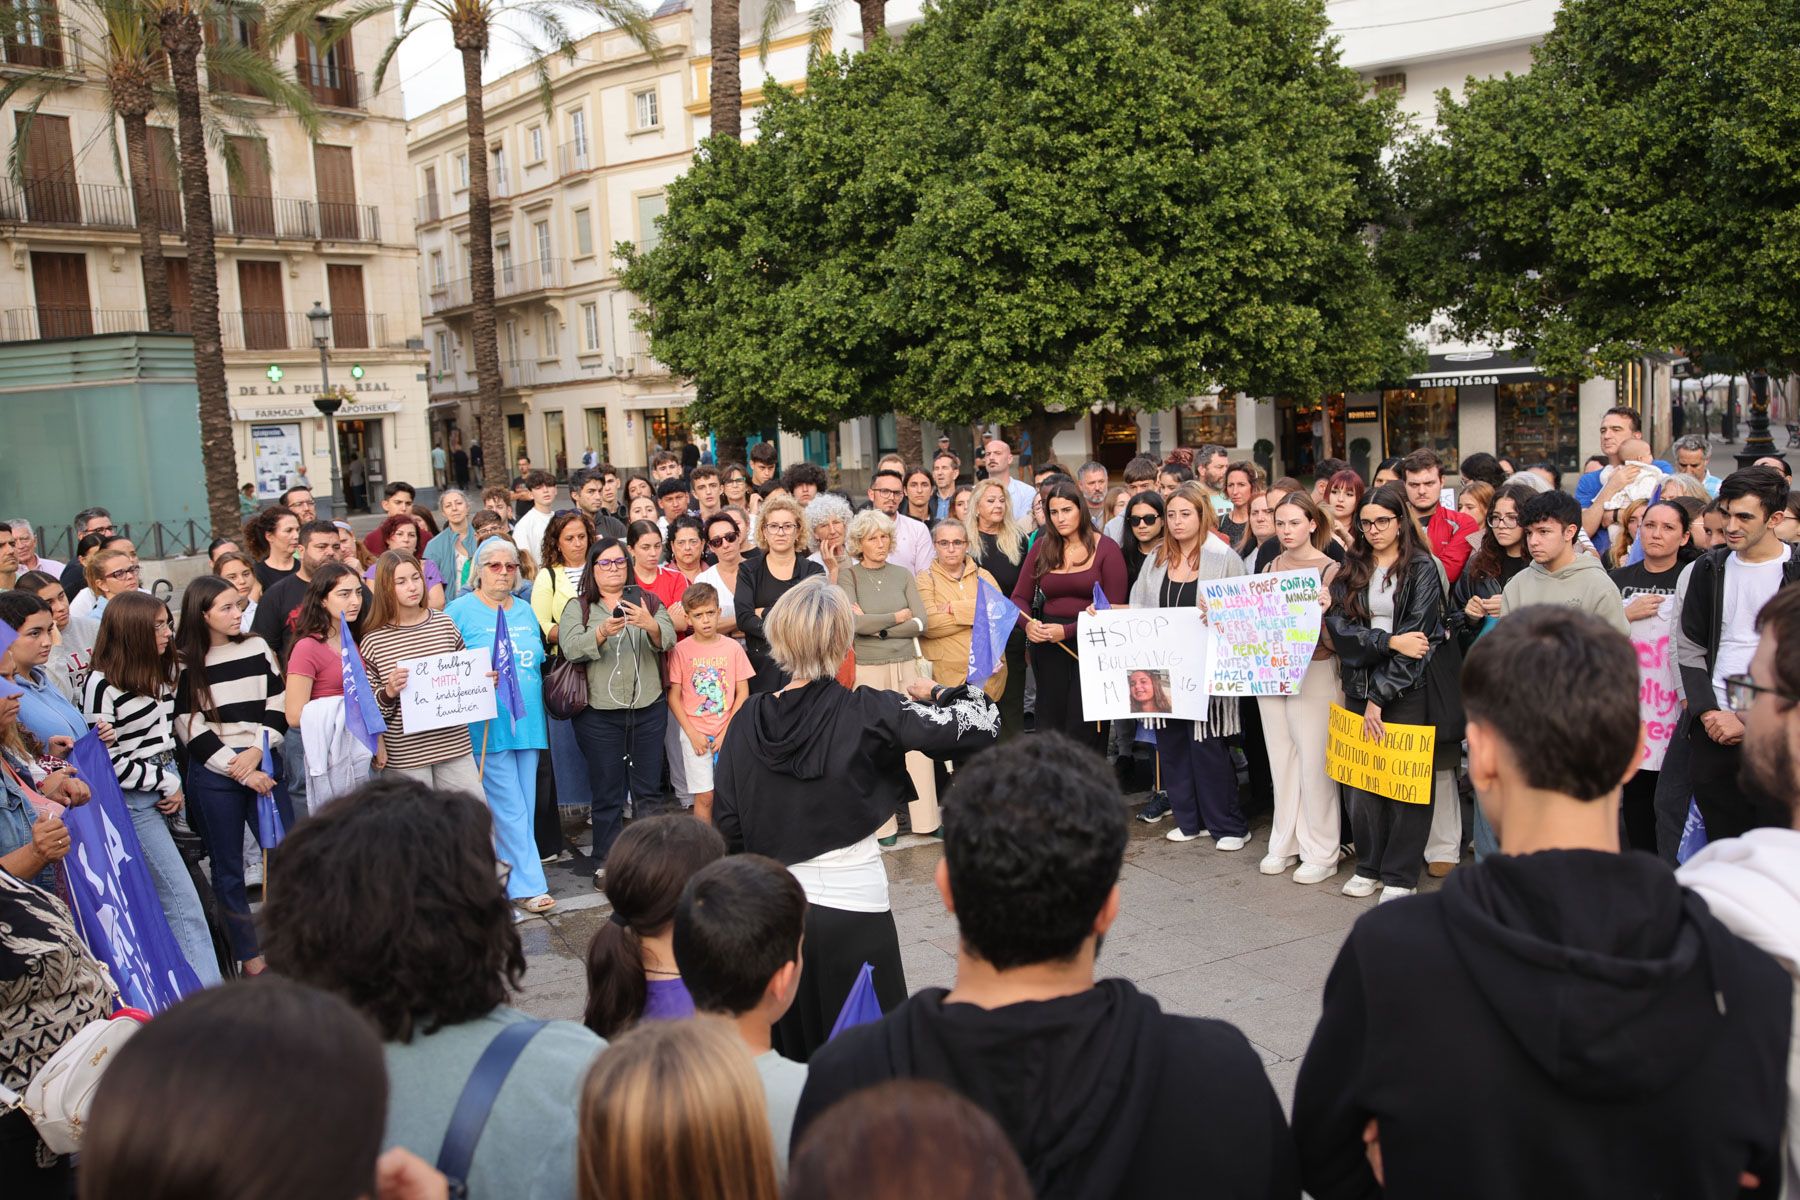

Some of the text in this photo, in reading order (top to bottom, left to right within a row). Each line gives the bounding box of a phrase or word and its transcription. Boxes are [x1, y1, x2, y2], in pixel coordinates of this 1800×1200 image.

[240, 380, 390, 396] DE LA PUETA REAL
[1420, 375, 1499, 388] miscelánea
[255, 403, 389, 418] FARMACIA APOTHEKE
[1206, 584, 1222, 599] NO
[1254, 615, 1297, 631] VALIENTE
[1086, 615, 1169, 648] #STOP
[415, 661, 429, 676] El
[1098, 650, 1184, 672] BULLYING
[1255, 655, 1269, 668] DE
[1271, 655, 1289, 668] QUE
[1214, 669, 1254, 681] HAZLO
[414, 685, 488, 706] la indiferencia
[1420, 734, 1433, 753] DE
[1335, 738, 1369, 766] INSTITUTO
[1373, 755, 1387, 772] NO
[1391, 758, 1431, 779] CUENTA
[1337, 764, 1354, 785] QUE
[1361, 771, 1380, 794] UNA
[1389, 780, 1417, 802] VIDA
